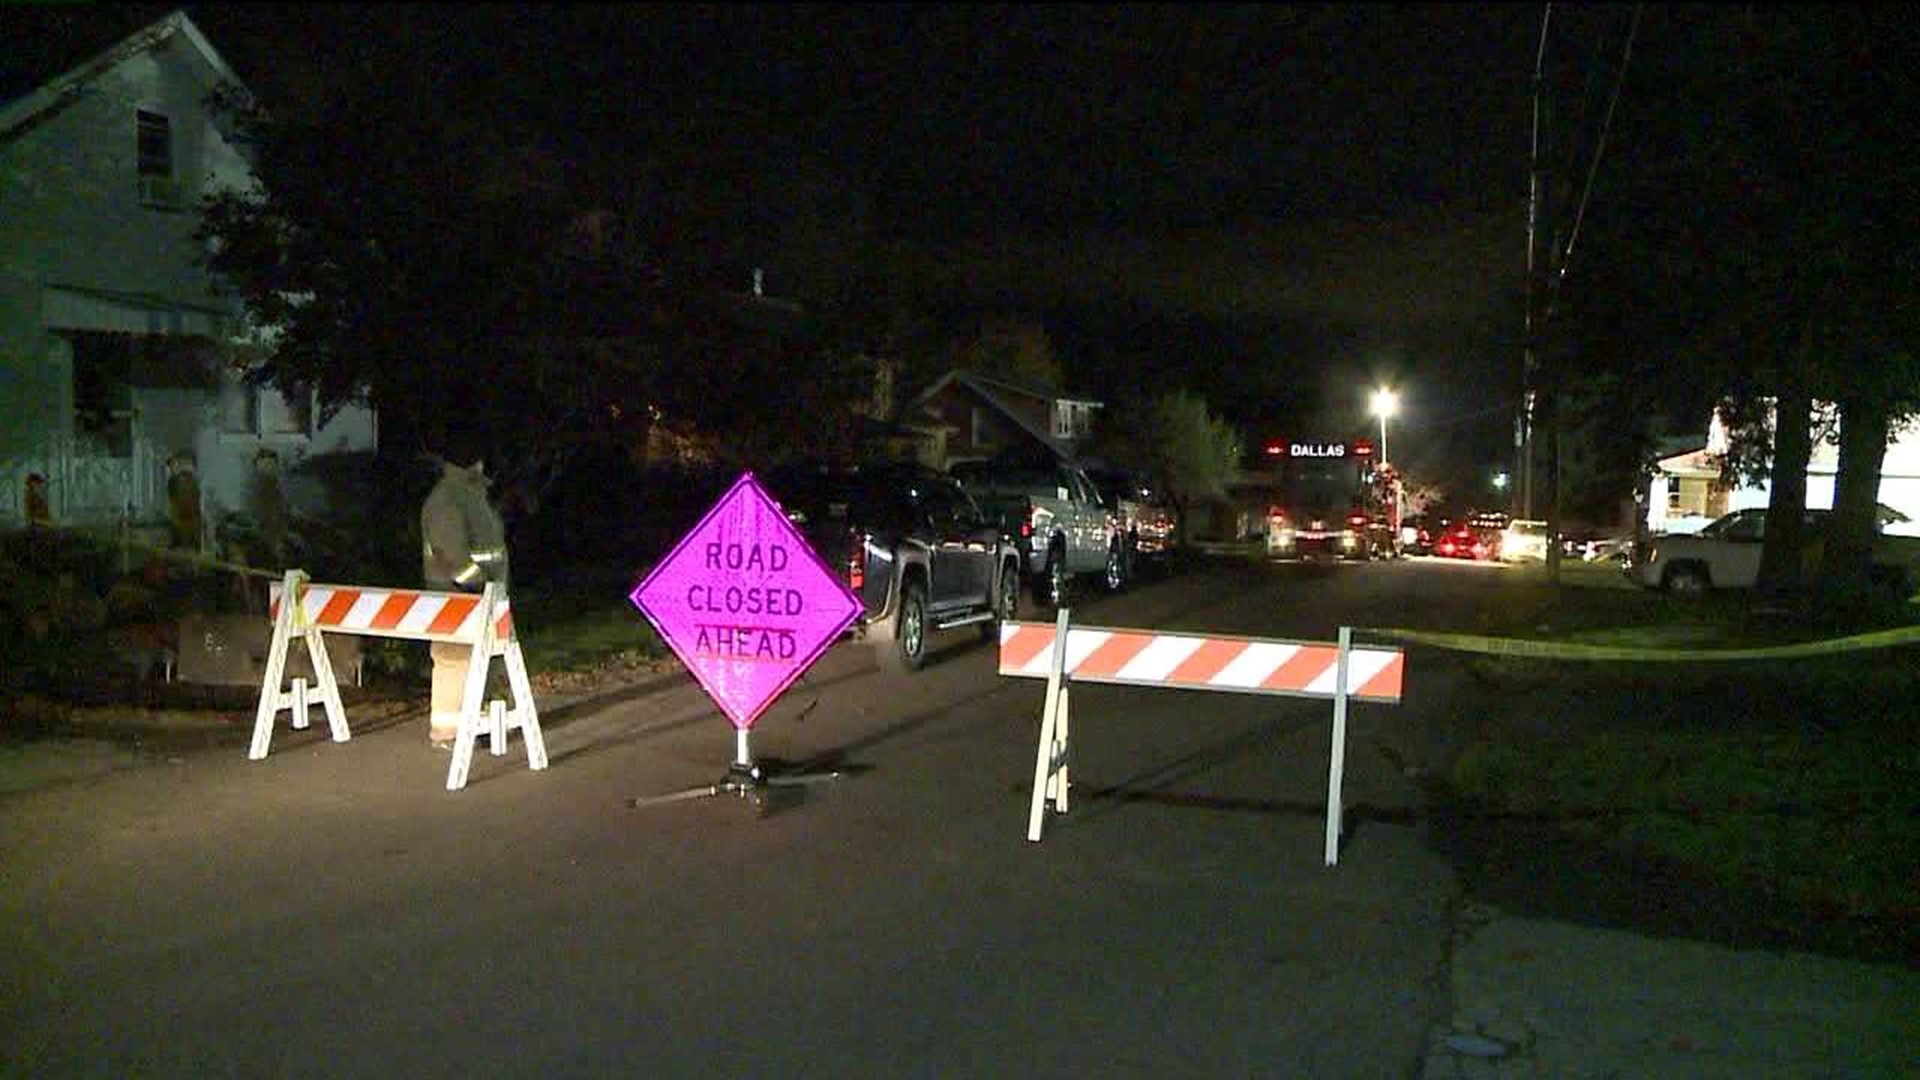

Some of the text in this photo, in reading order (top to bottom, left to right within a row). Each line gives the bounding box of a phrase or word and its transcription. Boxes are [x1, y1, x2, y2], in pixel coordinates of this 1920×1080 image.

[1291, 444, 1344, 457] DALLAS
[706, 543, 788, 571] ROAD
[688, 585, 803, 616] CLOSED
[696, 627, 797, 659] AHEAD
